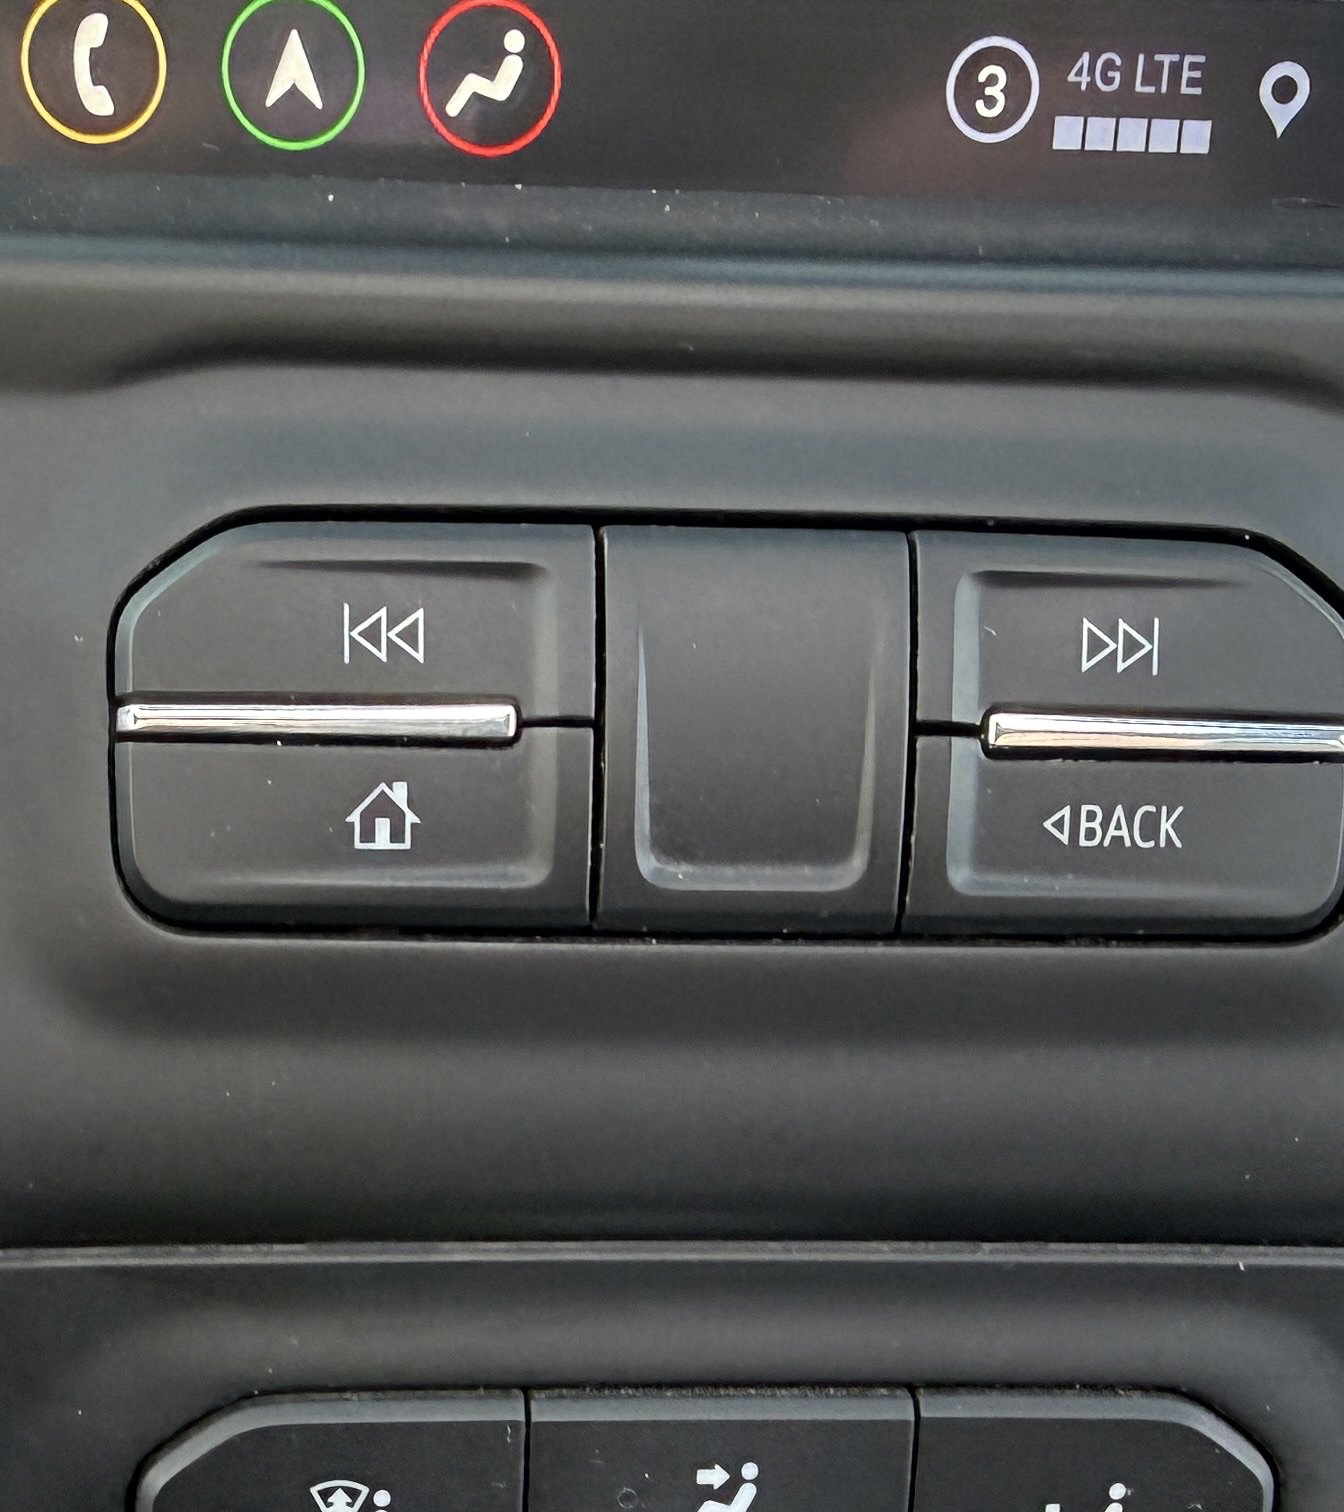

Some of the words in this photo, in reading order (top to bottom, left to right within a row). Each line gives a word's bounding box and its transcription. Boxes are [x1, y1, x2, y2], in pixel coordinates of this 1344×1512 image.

[975, 64, 1007, 118] 3
[1067, 52, 1122, 92] 4G
[1135, 53, 1206, 95] LTE
[1079, 803, 1185, 849] BACK
